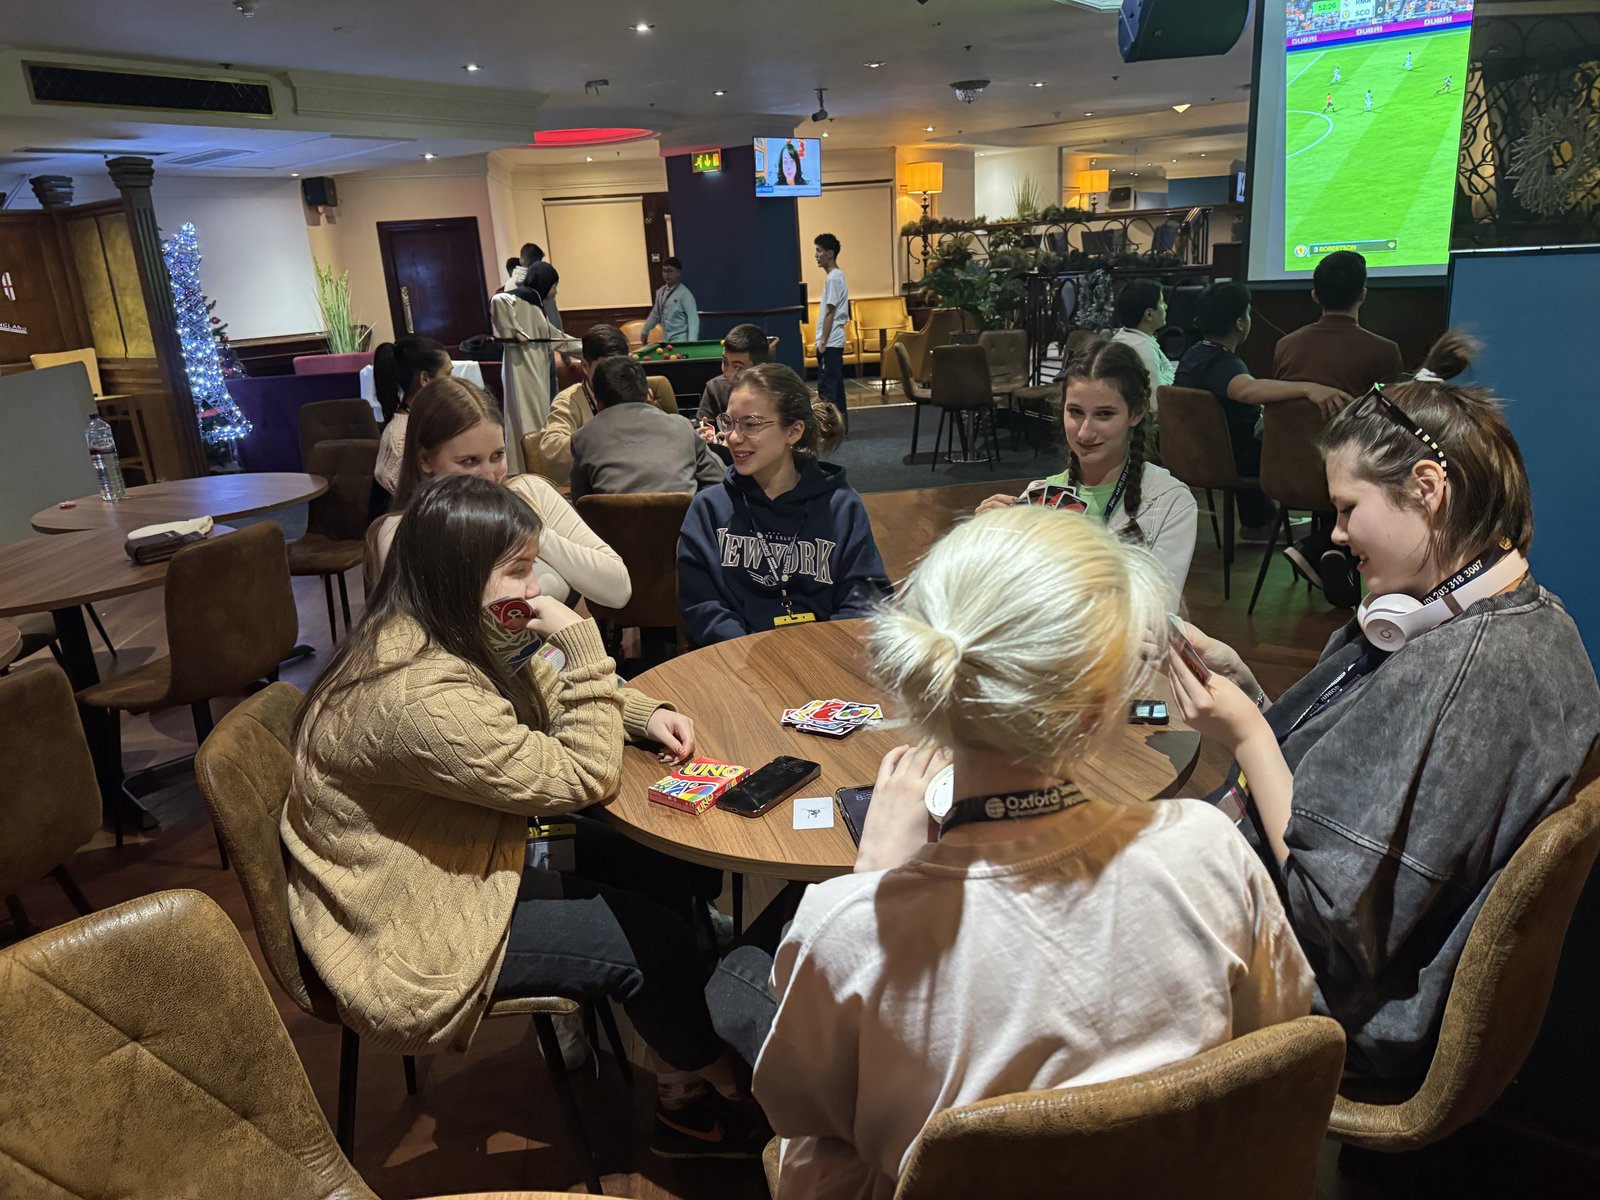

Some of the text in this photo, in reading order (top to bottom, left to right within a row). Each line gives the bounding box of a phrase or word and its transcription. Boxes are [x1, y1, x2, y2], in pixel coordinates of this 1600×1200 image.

[1355, 8, 1371, 17] SCO
[1319, 244, 1357, 253] ROBERTSON
[768, 538, 836, 584] YORK
[1433, 585, 1450, 599] 203
[1447, 574, 1465, 590] 318
[1463, 559, 1484, 578] 3007
[683, 762, 746, 779] UNO
[696, 792, 714, 815] UNO
[1005, 790, 1060, 810] Oxford
